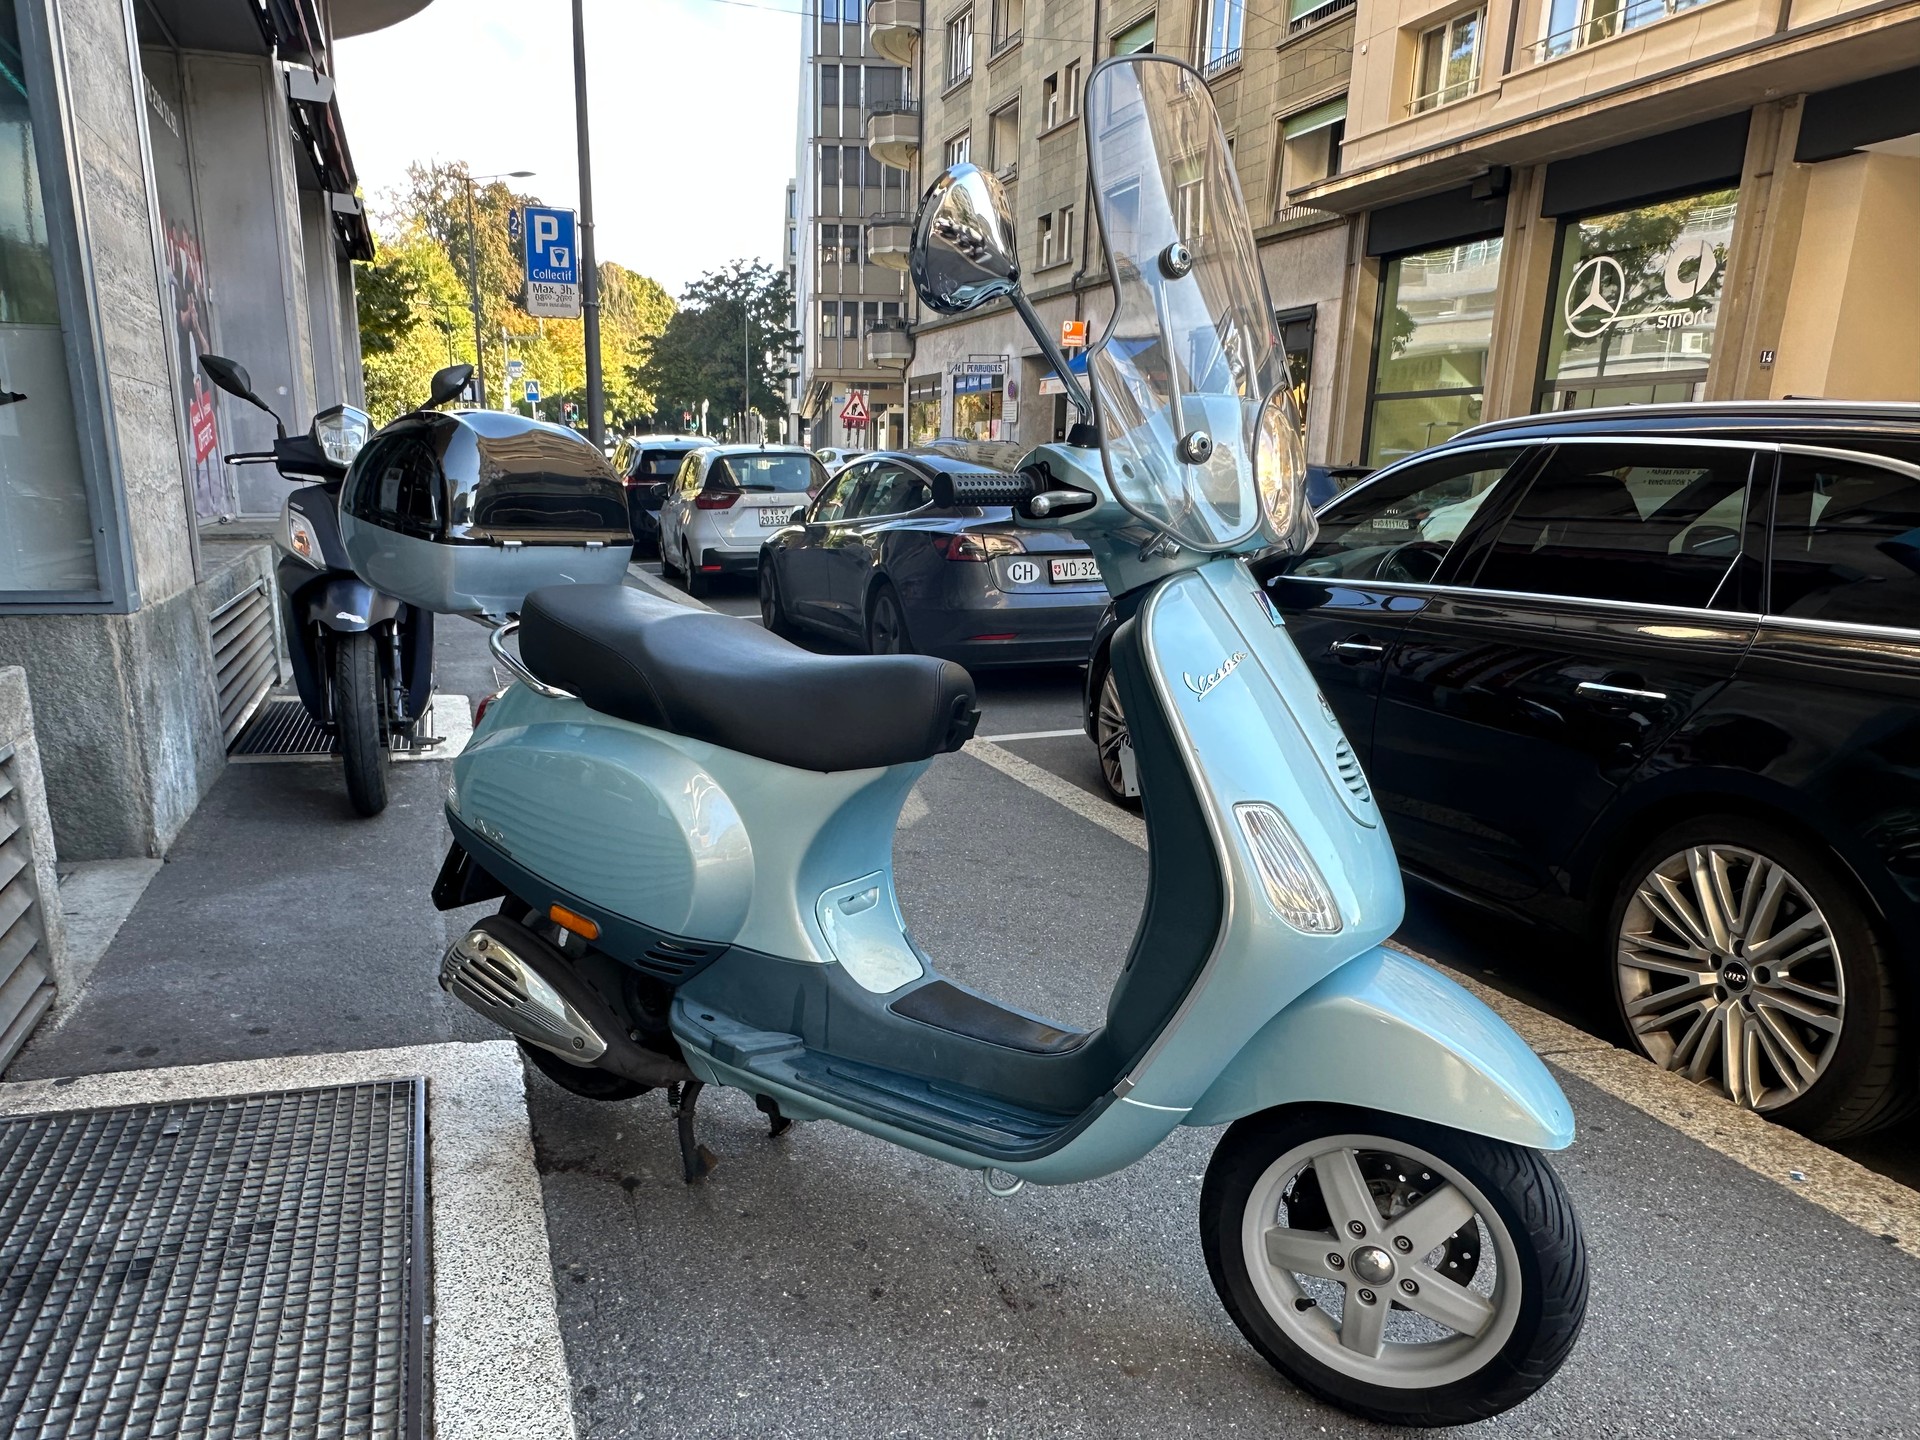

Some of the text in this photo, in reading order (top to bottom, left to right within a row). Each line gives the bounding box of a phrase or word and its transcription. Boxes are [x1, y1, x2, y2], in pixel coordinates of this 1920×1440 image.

[534, 215, 559, 254] P
[532, 269, 572, 281] Collectif
[1657, 307, 1709, 328] smart
[1761, 351, 1773, 363] 14
[1012, 564, 1034, 581] CH
[1183, 651, 1248, 702] Vespa
